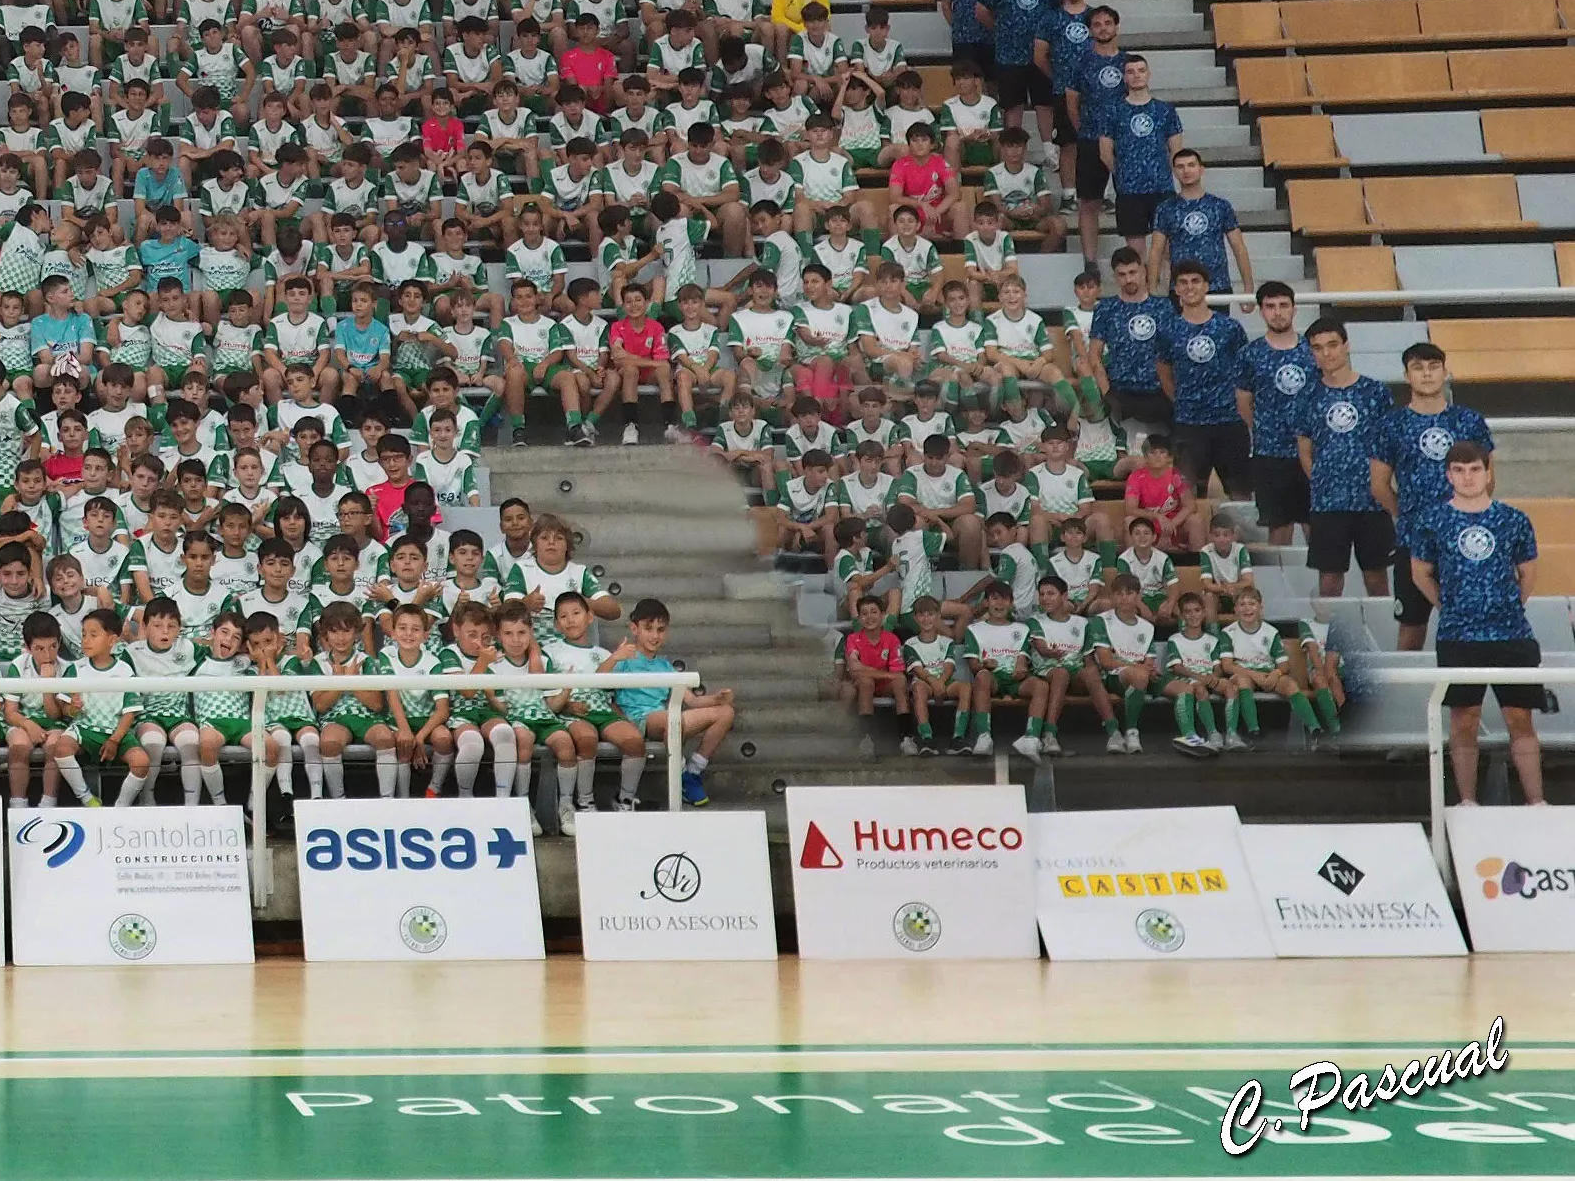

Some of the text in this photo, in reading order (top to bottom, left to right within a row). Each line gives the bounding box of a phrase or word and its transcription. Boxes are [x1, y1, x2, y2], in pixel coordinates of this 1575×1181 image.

[305, 827, 478, 871] asisa
[853, 820, 1023, 853] Humeco
[115, 854, 241, 864] CONSTRUCCIONES
[856, 856, 999, 870] Productos veterinarios
[599, 916, 759, 931] RUBIO ASESORES
[285, 1089, 1158, 1118] Patronato
[942, 1113, 1196, 1146] de
